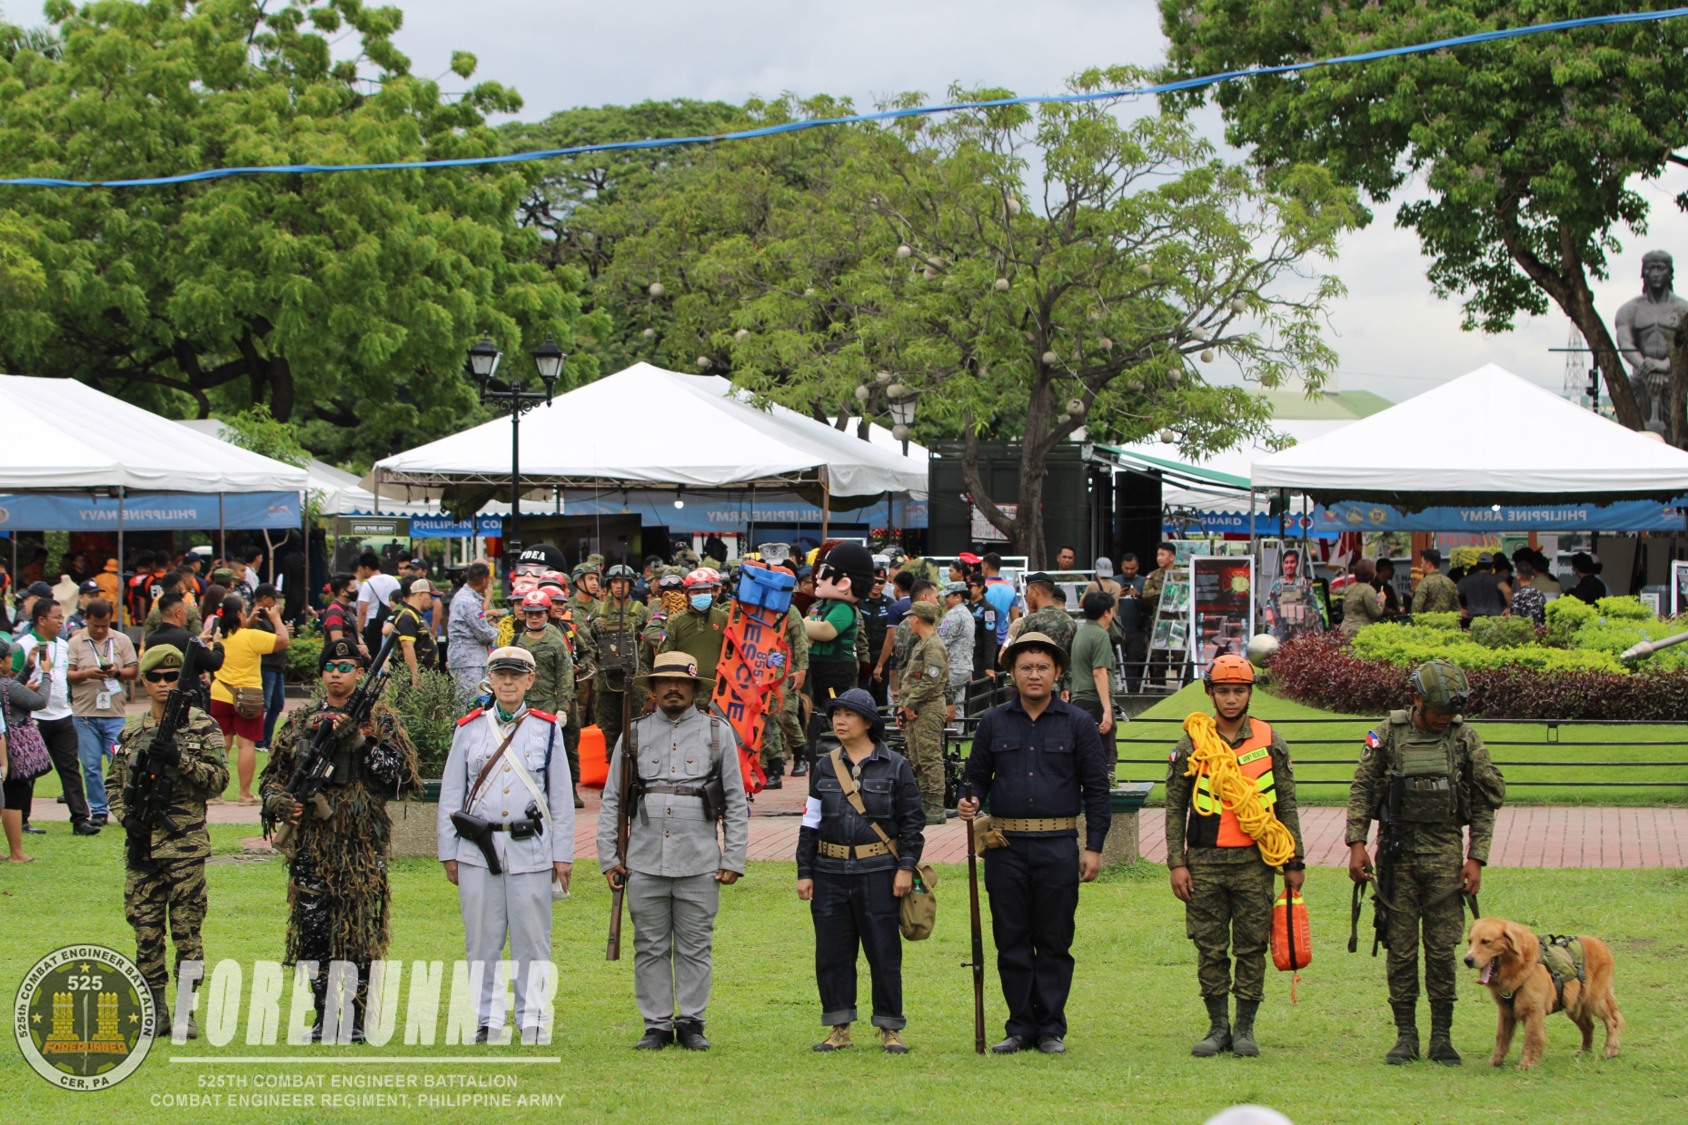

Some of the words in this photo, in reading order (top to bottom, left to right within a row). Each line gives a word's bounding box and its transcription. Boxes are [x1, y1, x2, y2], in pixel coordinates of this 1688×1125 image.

[413, 520, 479, 529] PHILIPIN
[520, 550, 546, 561] PDEA
[753, 651, 768, 677] 855
